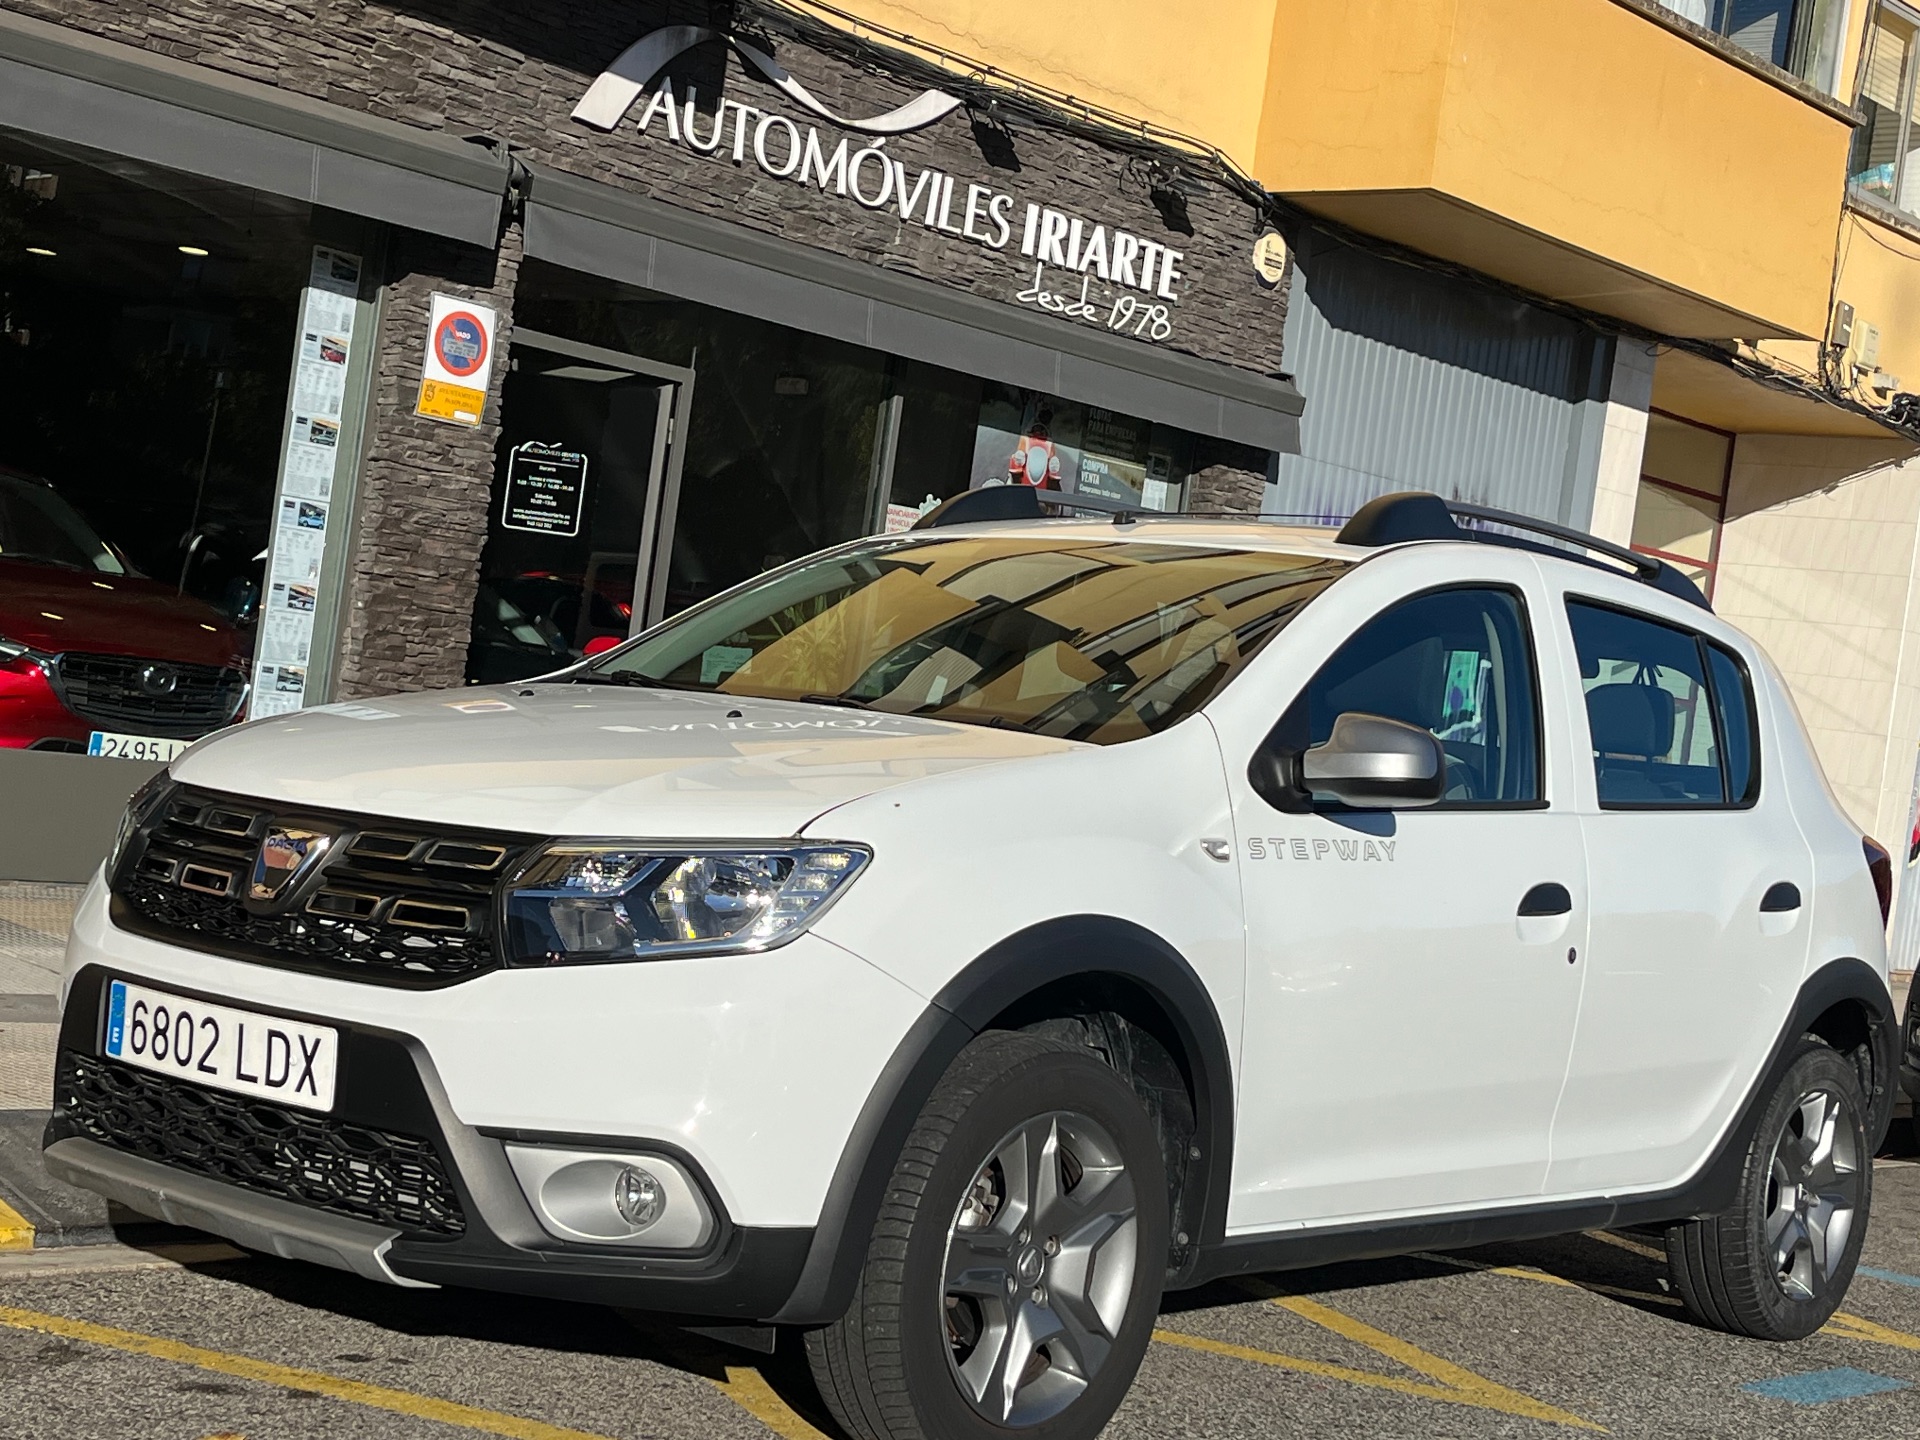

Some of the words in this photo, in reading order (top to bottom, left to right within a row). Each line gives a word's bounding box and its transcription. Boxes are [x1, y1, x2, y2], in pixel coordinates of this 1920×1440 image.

[637, 76, 1014, 249] AUTOMÓVILES
[1020, 203, 1185, 300] IRIARTE
[1015, 261, 1098, 322] desde
[1107, 295, 1172, 341] 1978
[1081, 470, 1100, 485] VENTA
[1082, 458, 1108, 474] COMPRA
[103, 738, 160, 761] 2495
[1247, 837, 1397, 862] STEPWAY
[130, 999, 220, 1076] 6802
[236, 1022, 322, 1097] LDX
